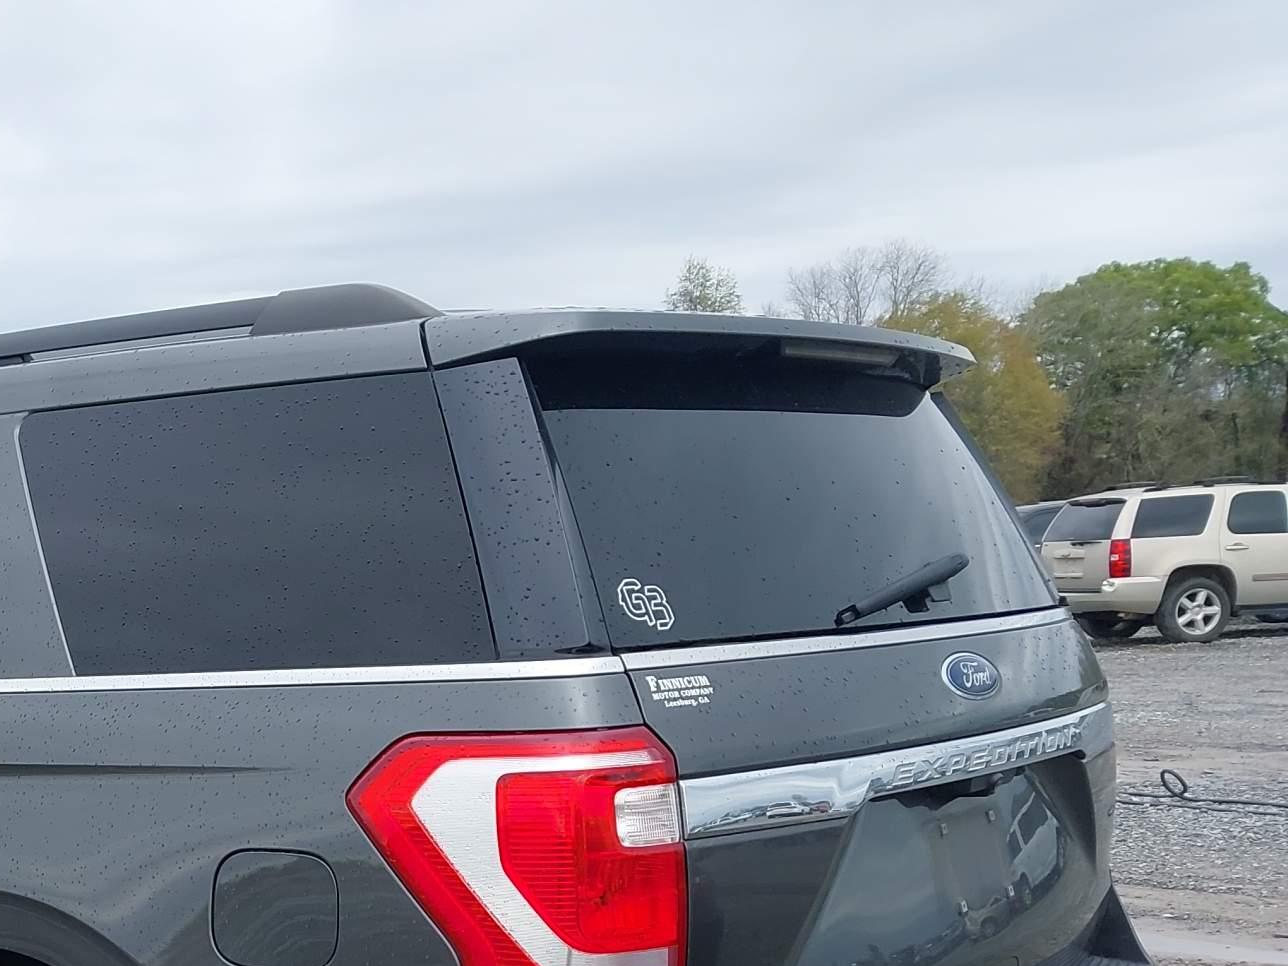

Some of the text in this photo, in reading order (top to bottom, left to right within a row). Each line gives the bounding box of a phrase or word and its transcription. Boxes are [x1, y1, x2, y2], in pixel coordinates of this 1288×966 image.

[959, 661, 991, 688] Ford
[652, 687, 713, 700] MOTOR COMPANY
[891, 725, 1081, 787] EXPEDITION
